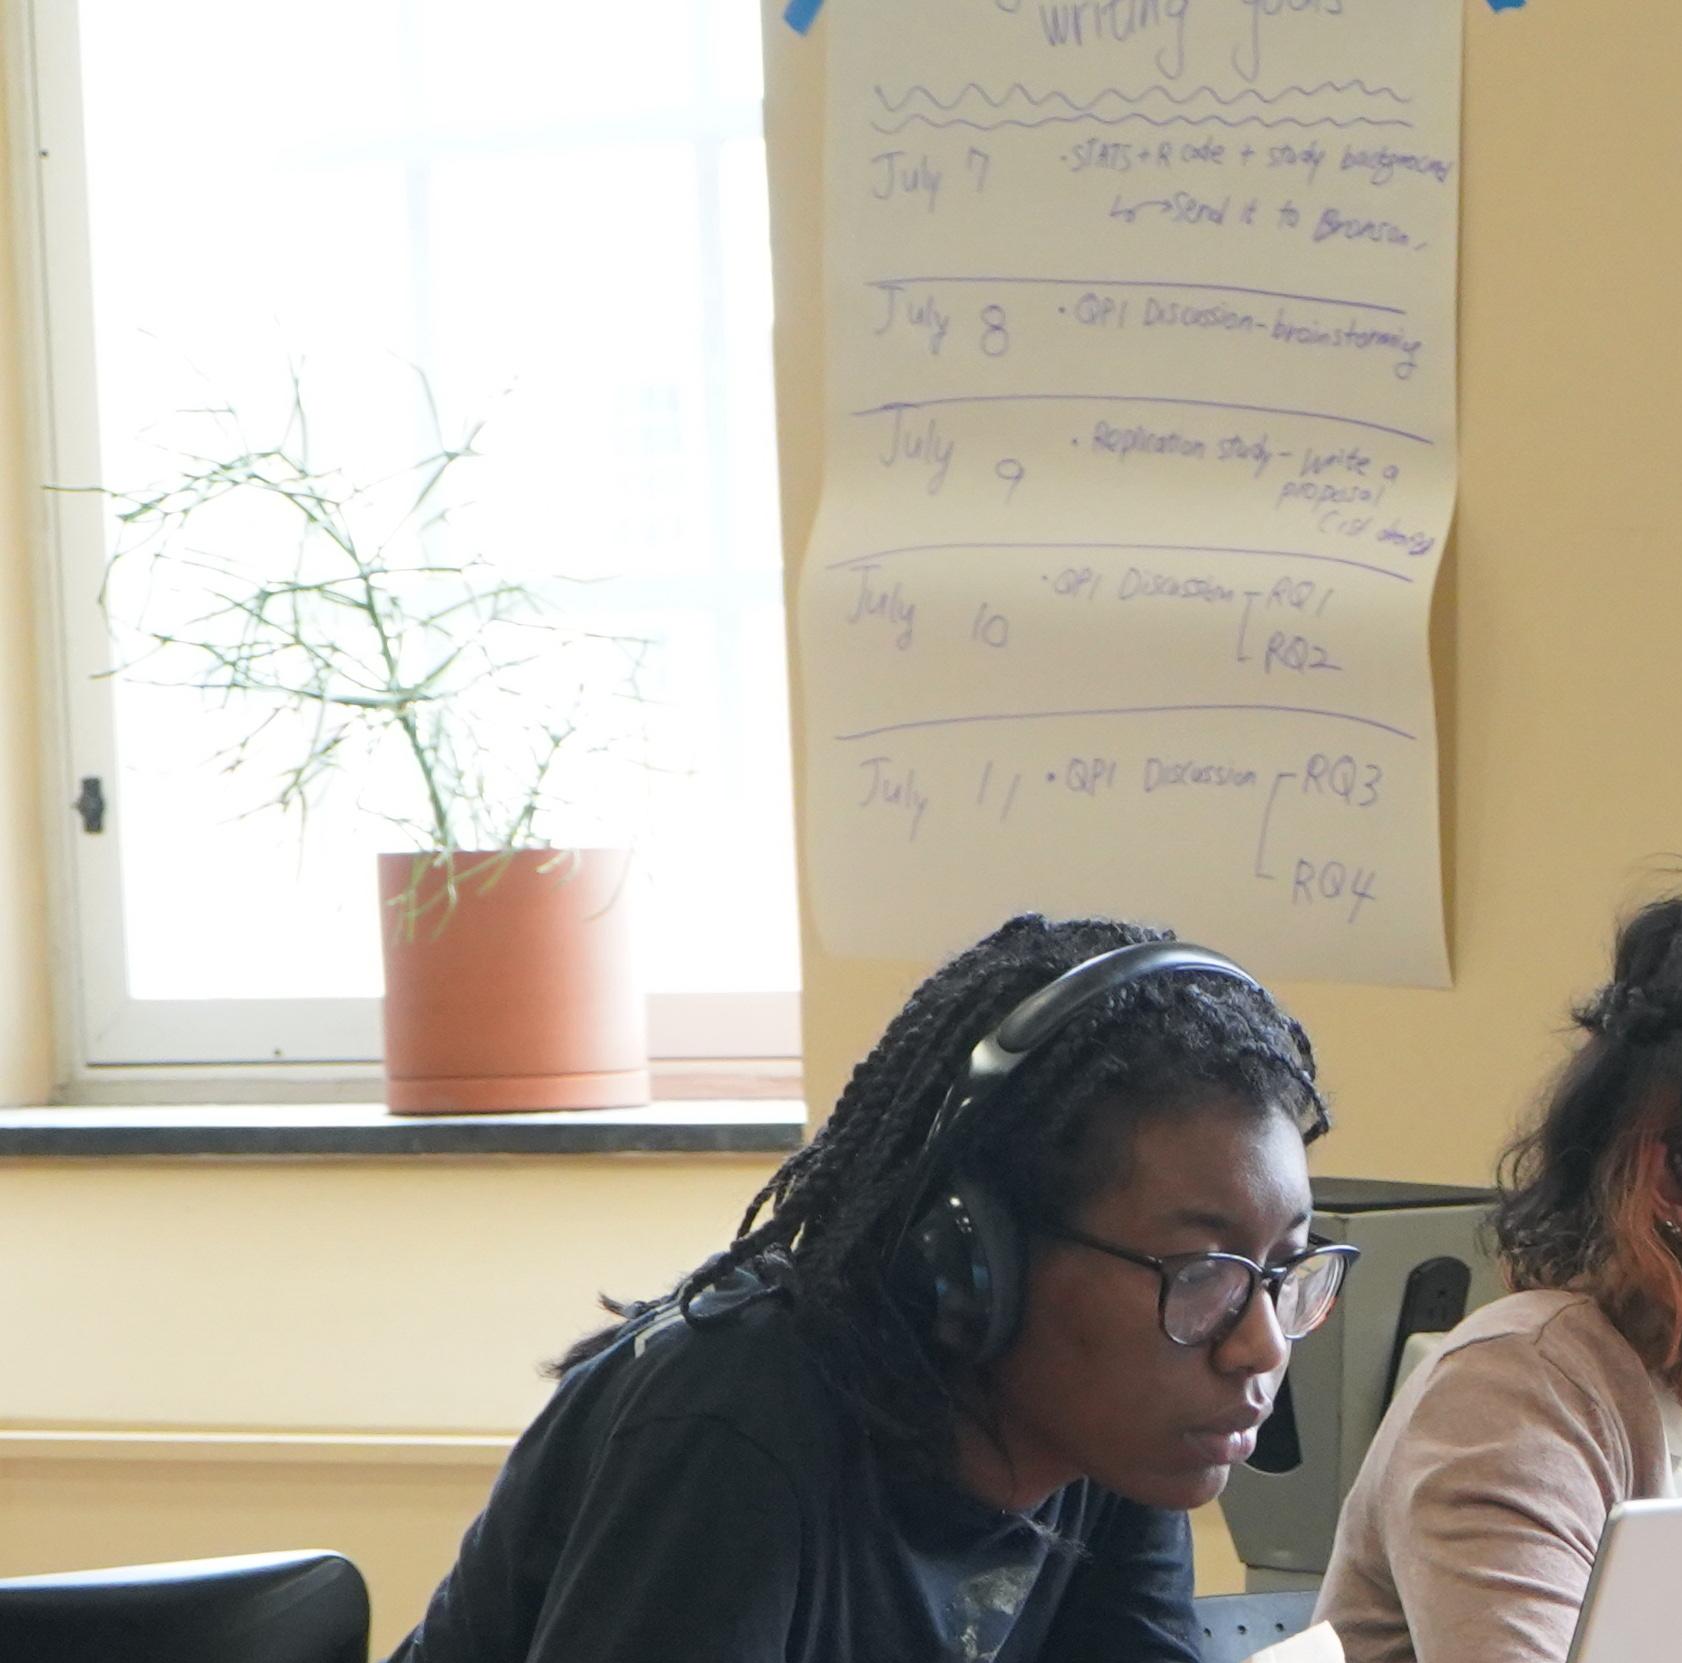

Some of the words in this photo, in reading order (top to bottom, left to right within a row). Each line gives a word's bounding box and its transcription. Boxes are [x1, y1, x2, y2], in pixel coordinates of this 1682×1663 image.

[870, 150, 943, 215] July
[966, 145, 990, 193] 7
[1266, 139, 1327, 185] study
[873, 283, 950, 356] July
[979, 303, 1010, 358] 8
[879, 402, 955, 496] July
[993, 457, 1026, 506] 9
[846, 563, 916, 652] July
[970, 601, 1010, 649] 10
[1264, 630, 1343, 675] RQ2
[858, 755, 929, 843] July
[976, 759, 1022, 823] 11
[1143, 757, 1258, 793] Discussion
[1302, 752, 1383, 808] RQ3
[1291, 857, 1377, 925] RQ4
